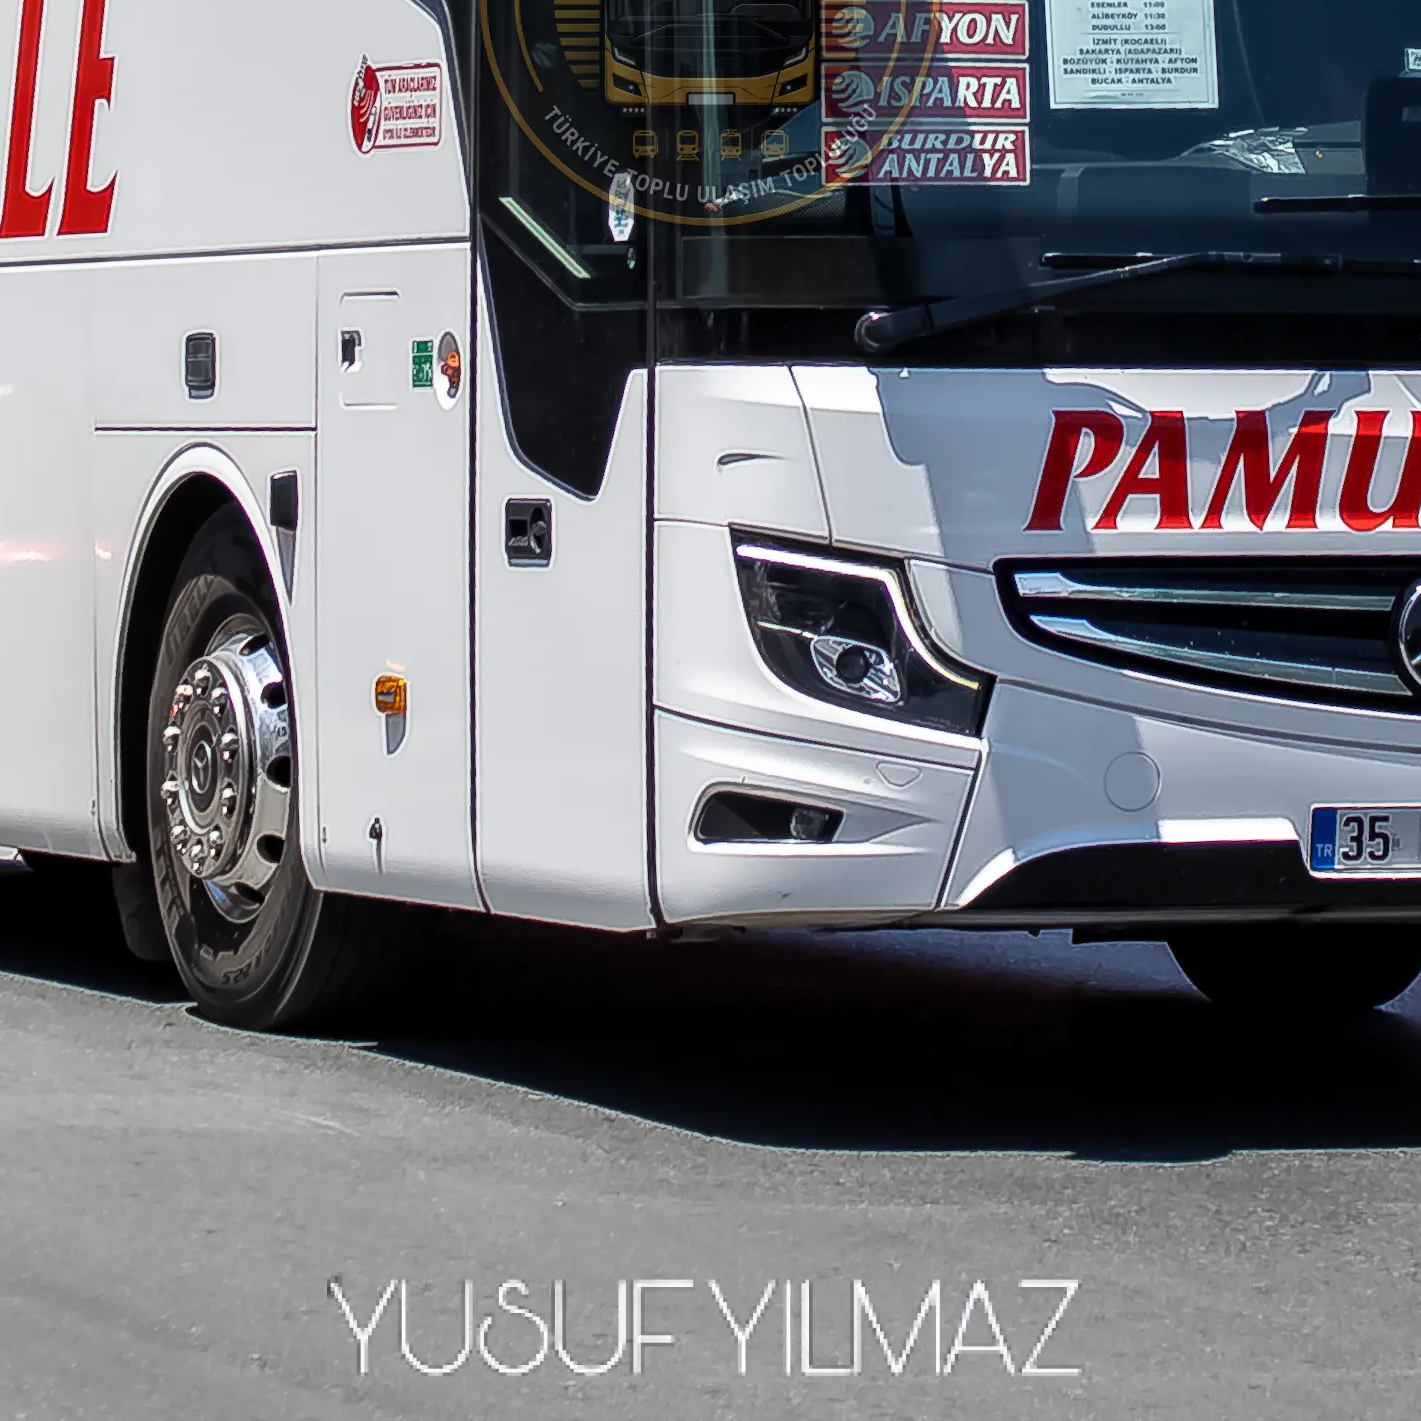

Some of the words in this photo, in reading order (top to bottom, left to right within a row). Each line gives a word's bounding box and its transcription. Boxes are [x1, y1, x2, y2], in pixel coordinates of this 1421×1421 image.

[878, 11, 1020, 46] AFYON
[1078, 48, 1121, 56] SAKARYA
[1131, 77, 1173, 85] ANTALYA
[1161, 67, 1198, 75] BURDUR
[878, 77, 1021, 109] ISPARTA
[880, 132, 1017, 151] BURDUR
[878, 153, 1019, 179] ANTALYA
[1315, 843, 1333, 858] TR
[1340, 814, 1391, 862] 35
